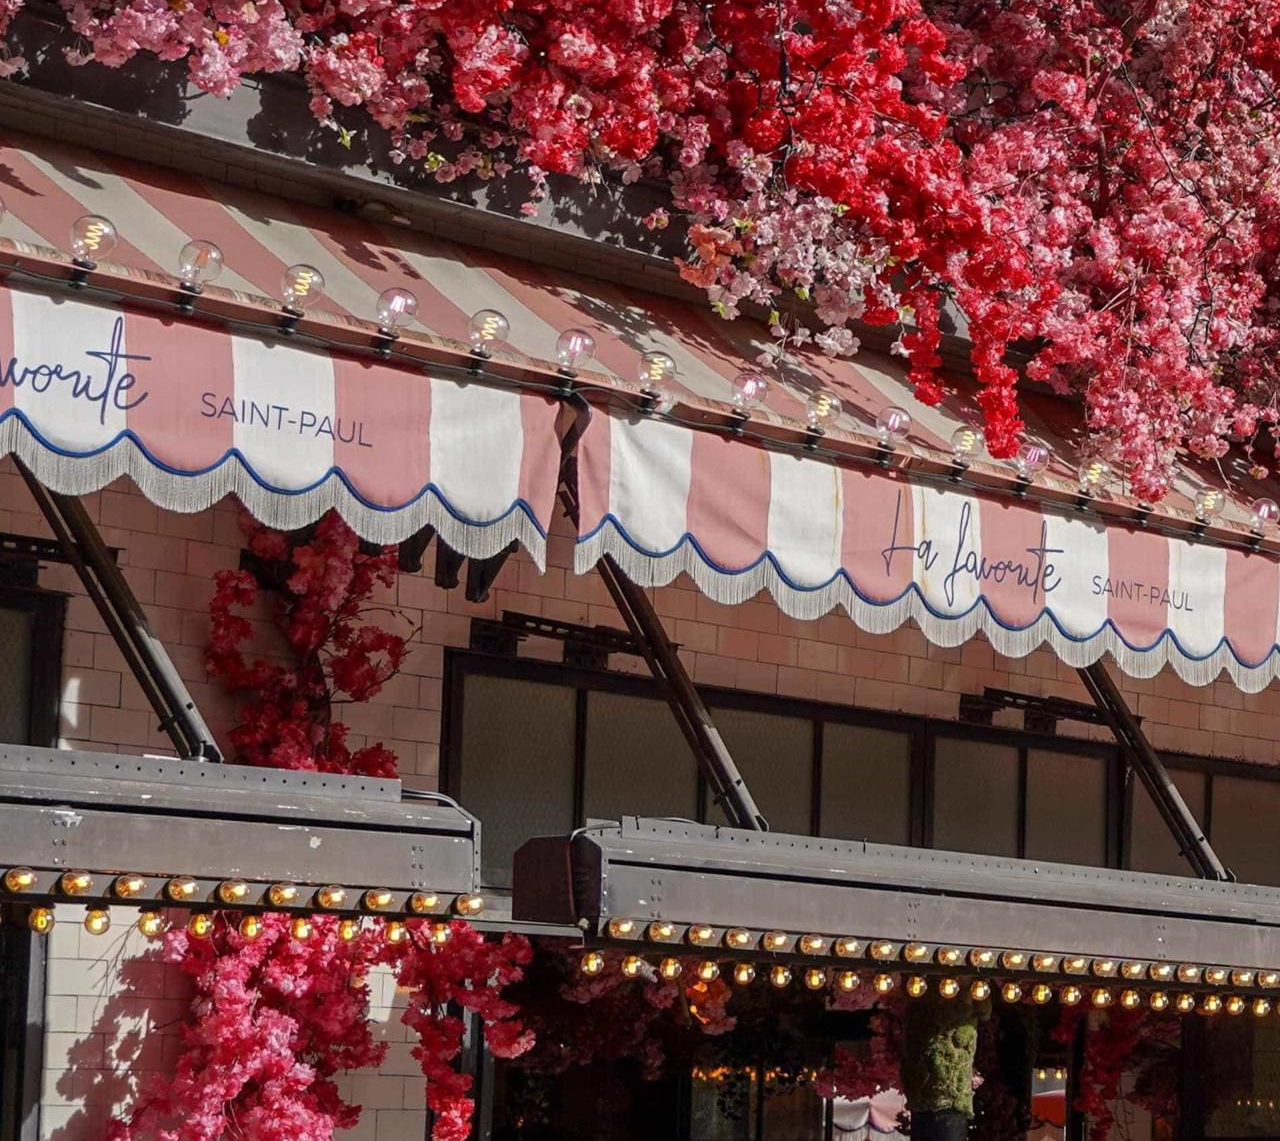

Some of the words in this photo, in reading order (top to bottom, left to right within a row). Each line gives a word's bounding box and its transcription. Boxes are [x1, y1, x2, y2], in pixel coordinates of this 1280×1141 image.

[0, 316, 152, 426] vorite
[200, 391, 373, 448] SAINT-PAUL
[881, 488, 939, 576] La
[944, 502, 1064, 606] favorite
[1092, 574, 1194, 612] SAINT-PAUL
